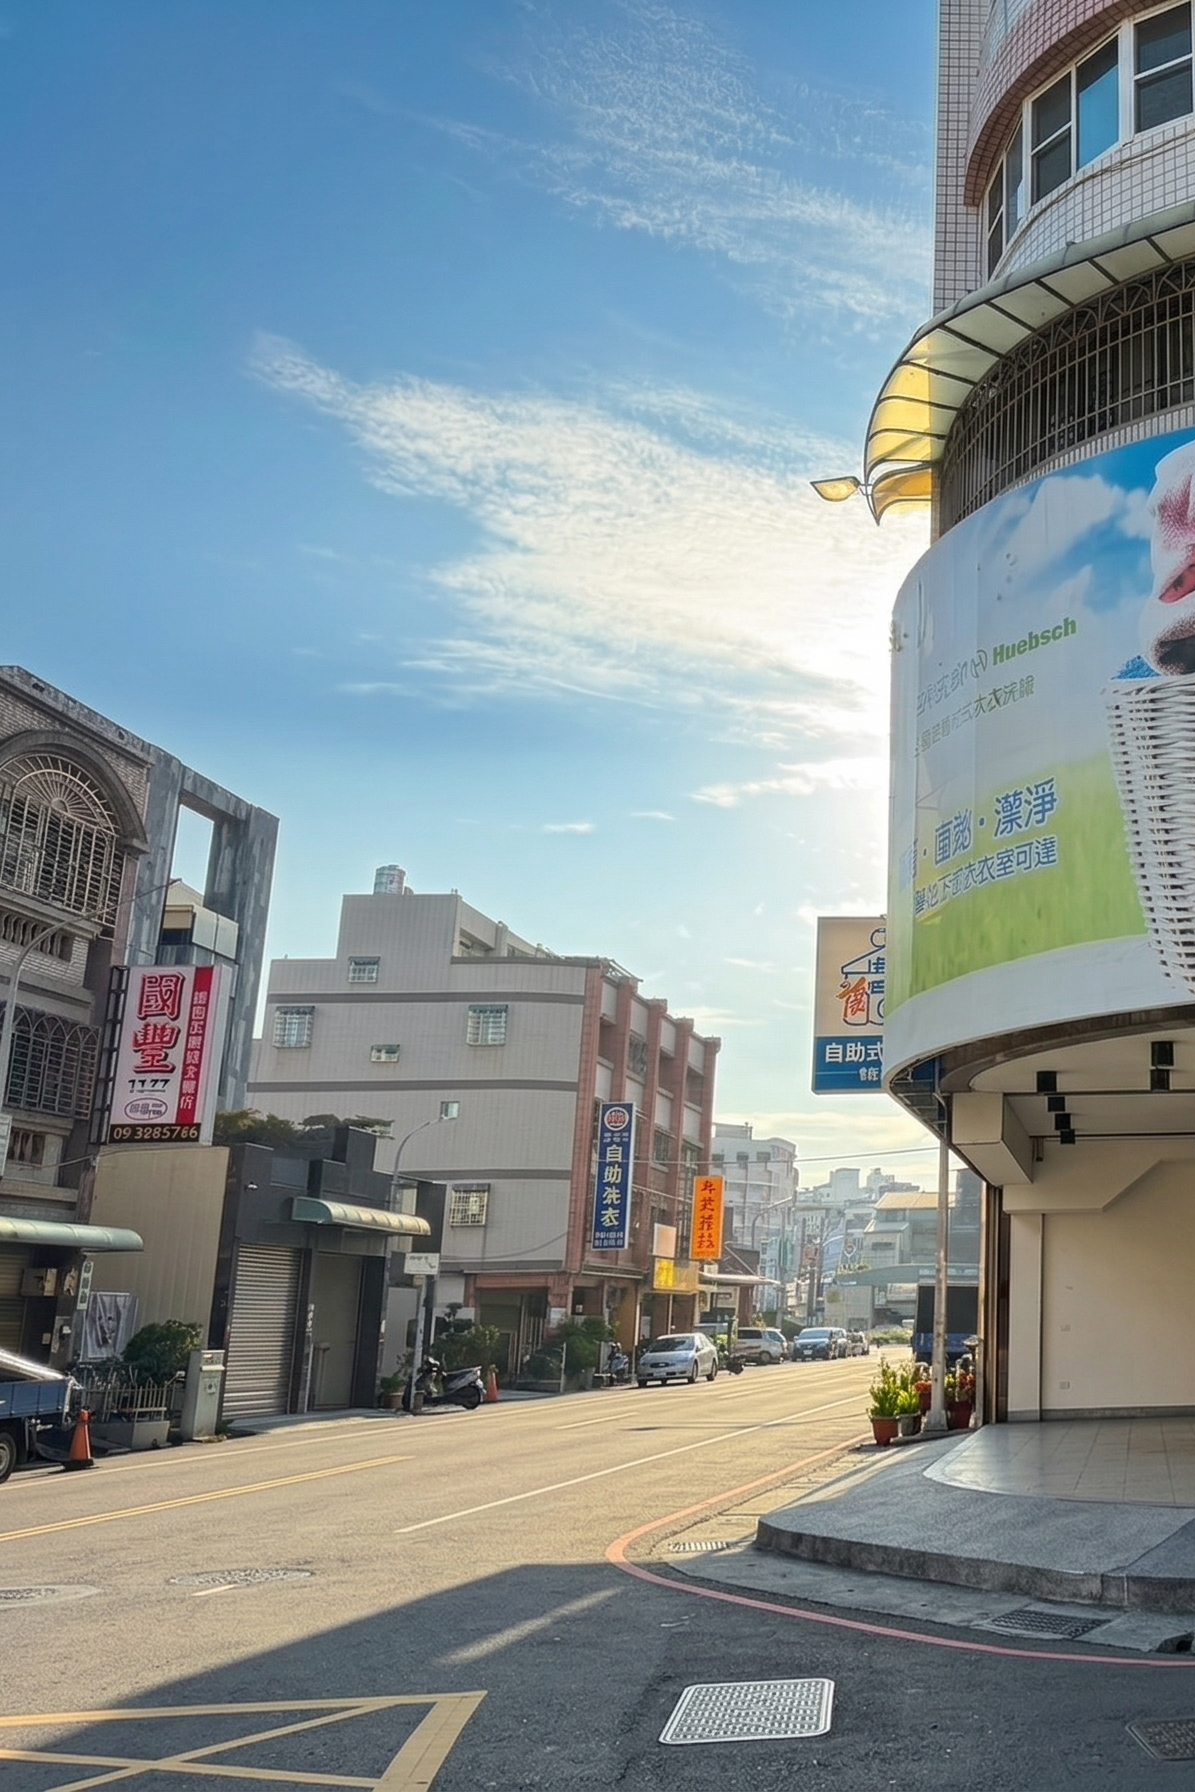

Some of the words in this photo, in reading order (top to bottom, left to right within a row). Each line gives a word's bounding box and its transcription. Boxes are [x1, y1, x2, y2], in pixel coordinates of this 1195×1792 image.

[992, 617, 1077, 665] Huebsch
[600, 1144, 623, 1227] 自助洗衣
